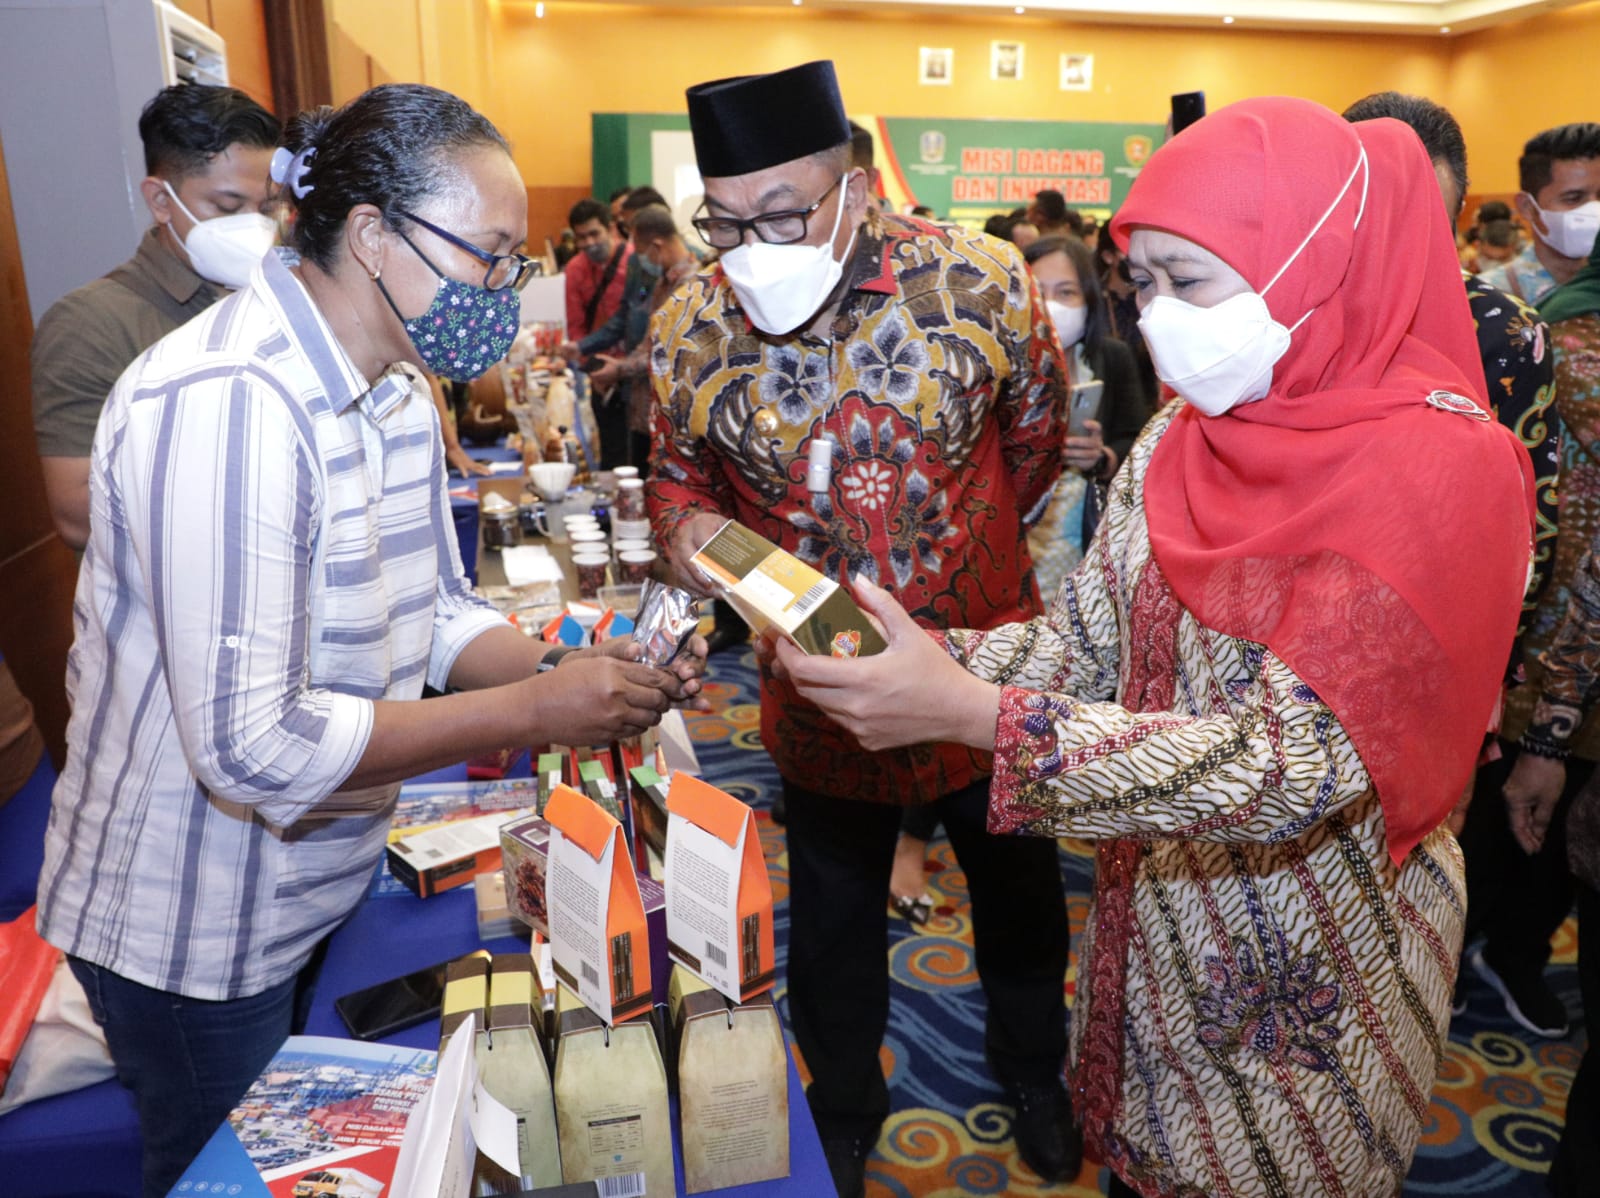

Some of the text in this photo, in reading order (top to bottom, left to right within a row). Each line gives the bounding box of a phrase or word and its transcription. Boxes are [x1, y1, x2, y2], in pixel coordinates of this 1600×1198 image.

[962, 148, 1013, 174] MISI
[1017, 149, 1104, 176] DAGANG
[953, 176, 998, 203] DAN
